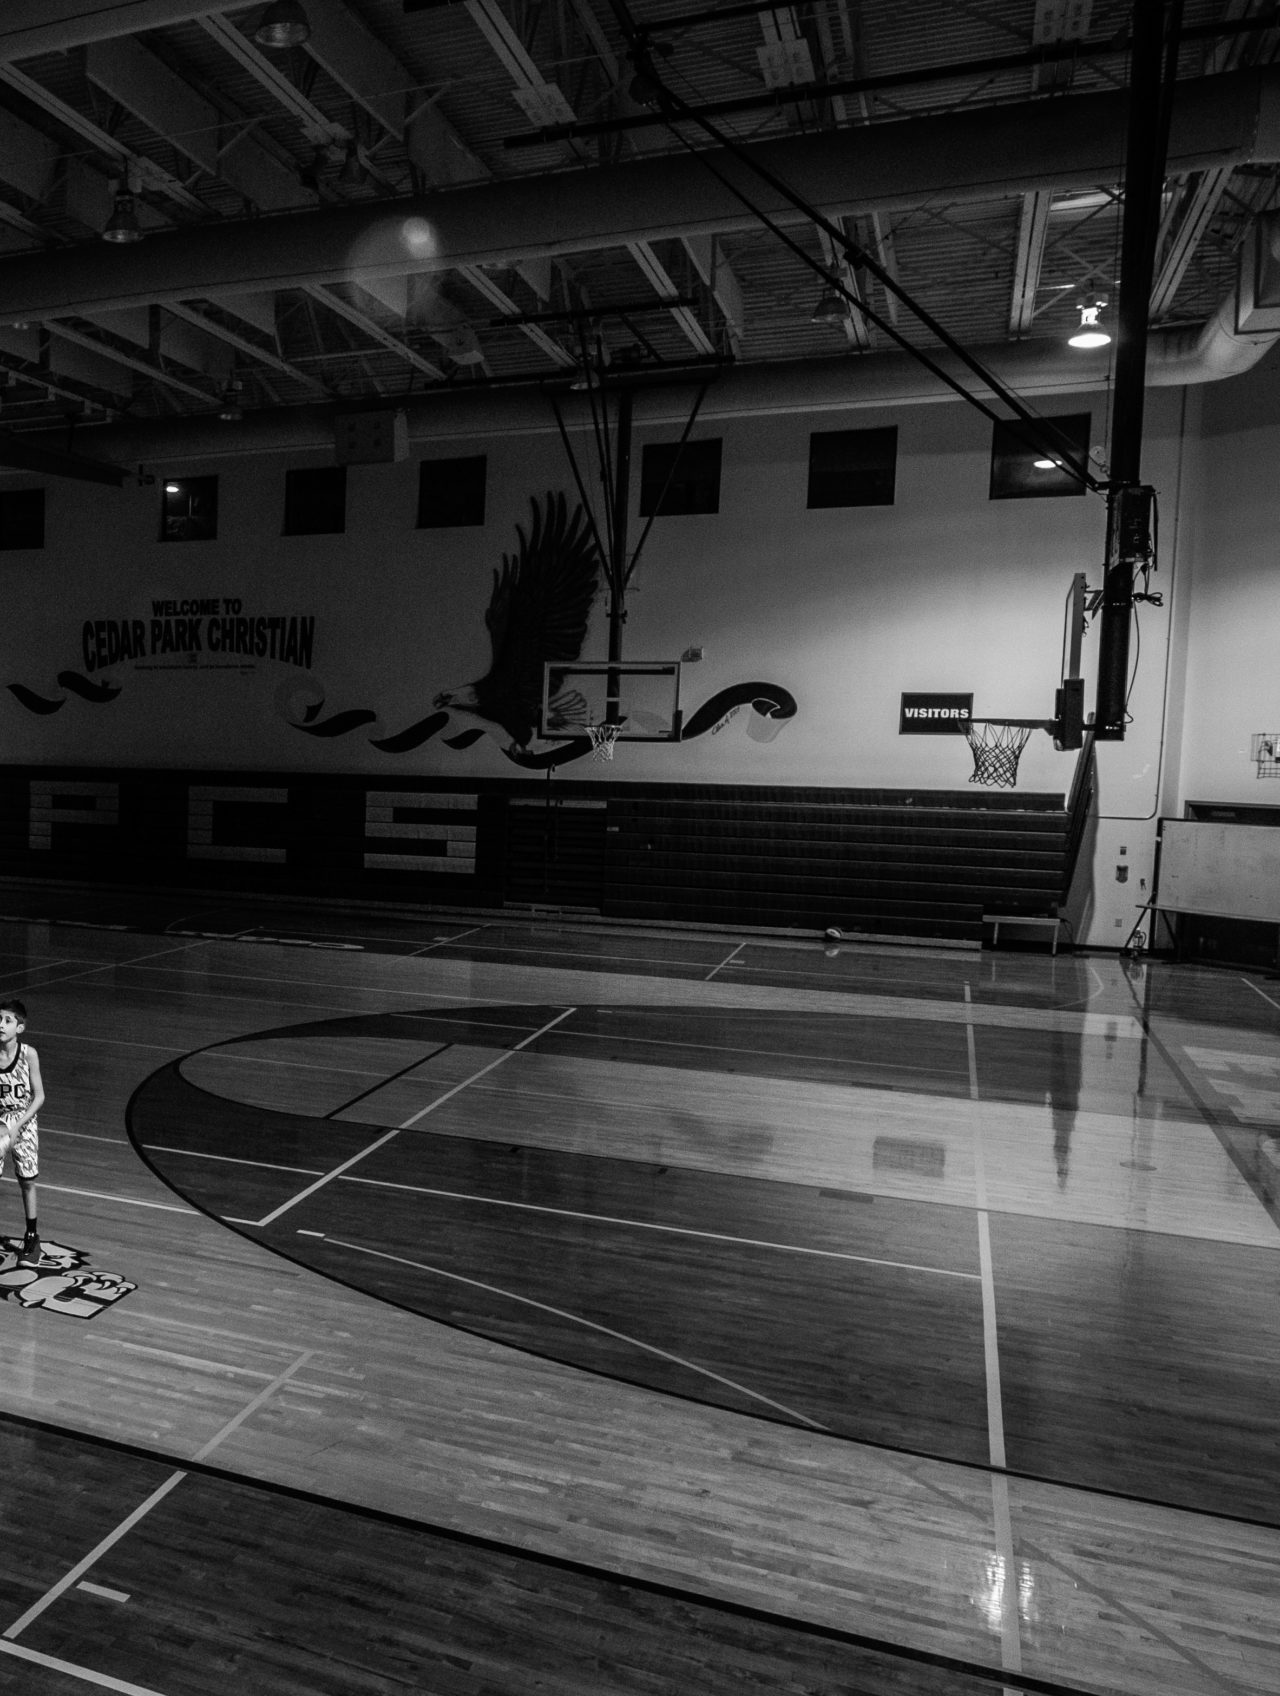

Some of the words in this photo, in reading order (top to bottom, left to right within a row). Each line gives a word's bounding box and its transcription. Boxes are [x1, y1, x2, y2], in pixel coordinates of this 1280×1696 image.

[152, 599, 219, 617] WELCOME
[223, 598, 242, 615] TO
[83, 620, 146, 672] CEDAR
[151, 617, 202, 654] PARK
[207, 616, 315, 669] CHRISTIAN
[904, 707, 970, 719] VISITORS
